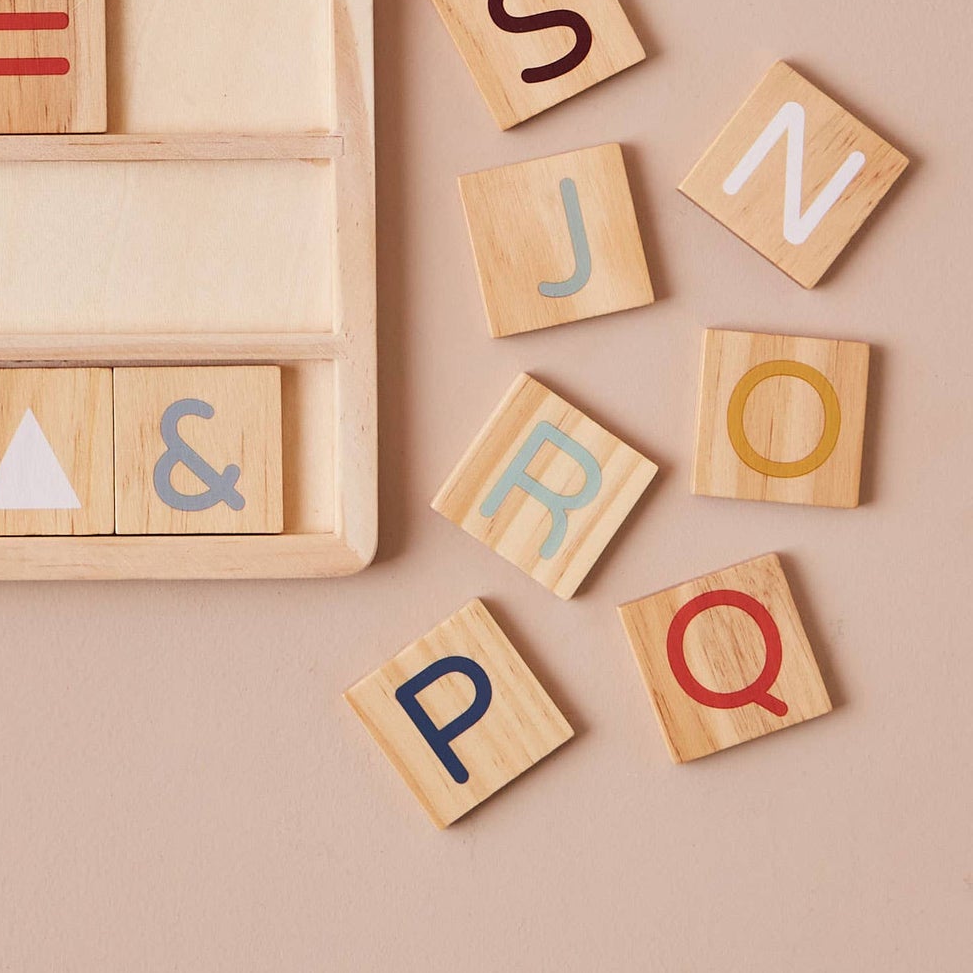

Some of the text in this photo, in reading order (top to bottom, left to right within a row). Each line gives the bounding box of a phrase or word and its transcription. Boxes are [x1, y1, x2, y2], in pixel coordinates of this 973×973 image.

[538, 177, 591, 297] J
[724, 102, 865, 245] N
[727, 360, 841, 478] O
[479, 421, 602, 558] R
[667, 590, 788, 717] Q
[395, 656, 492, 784] P
